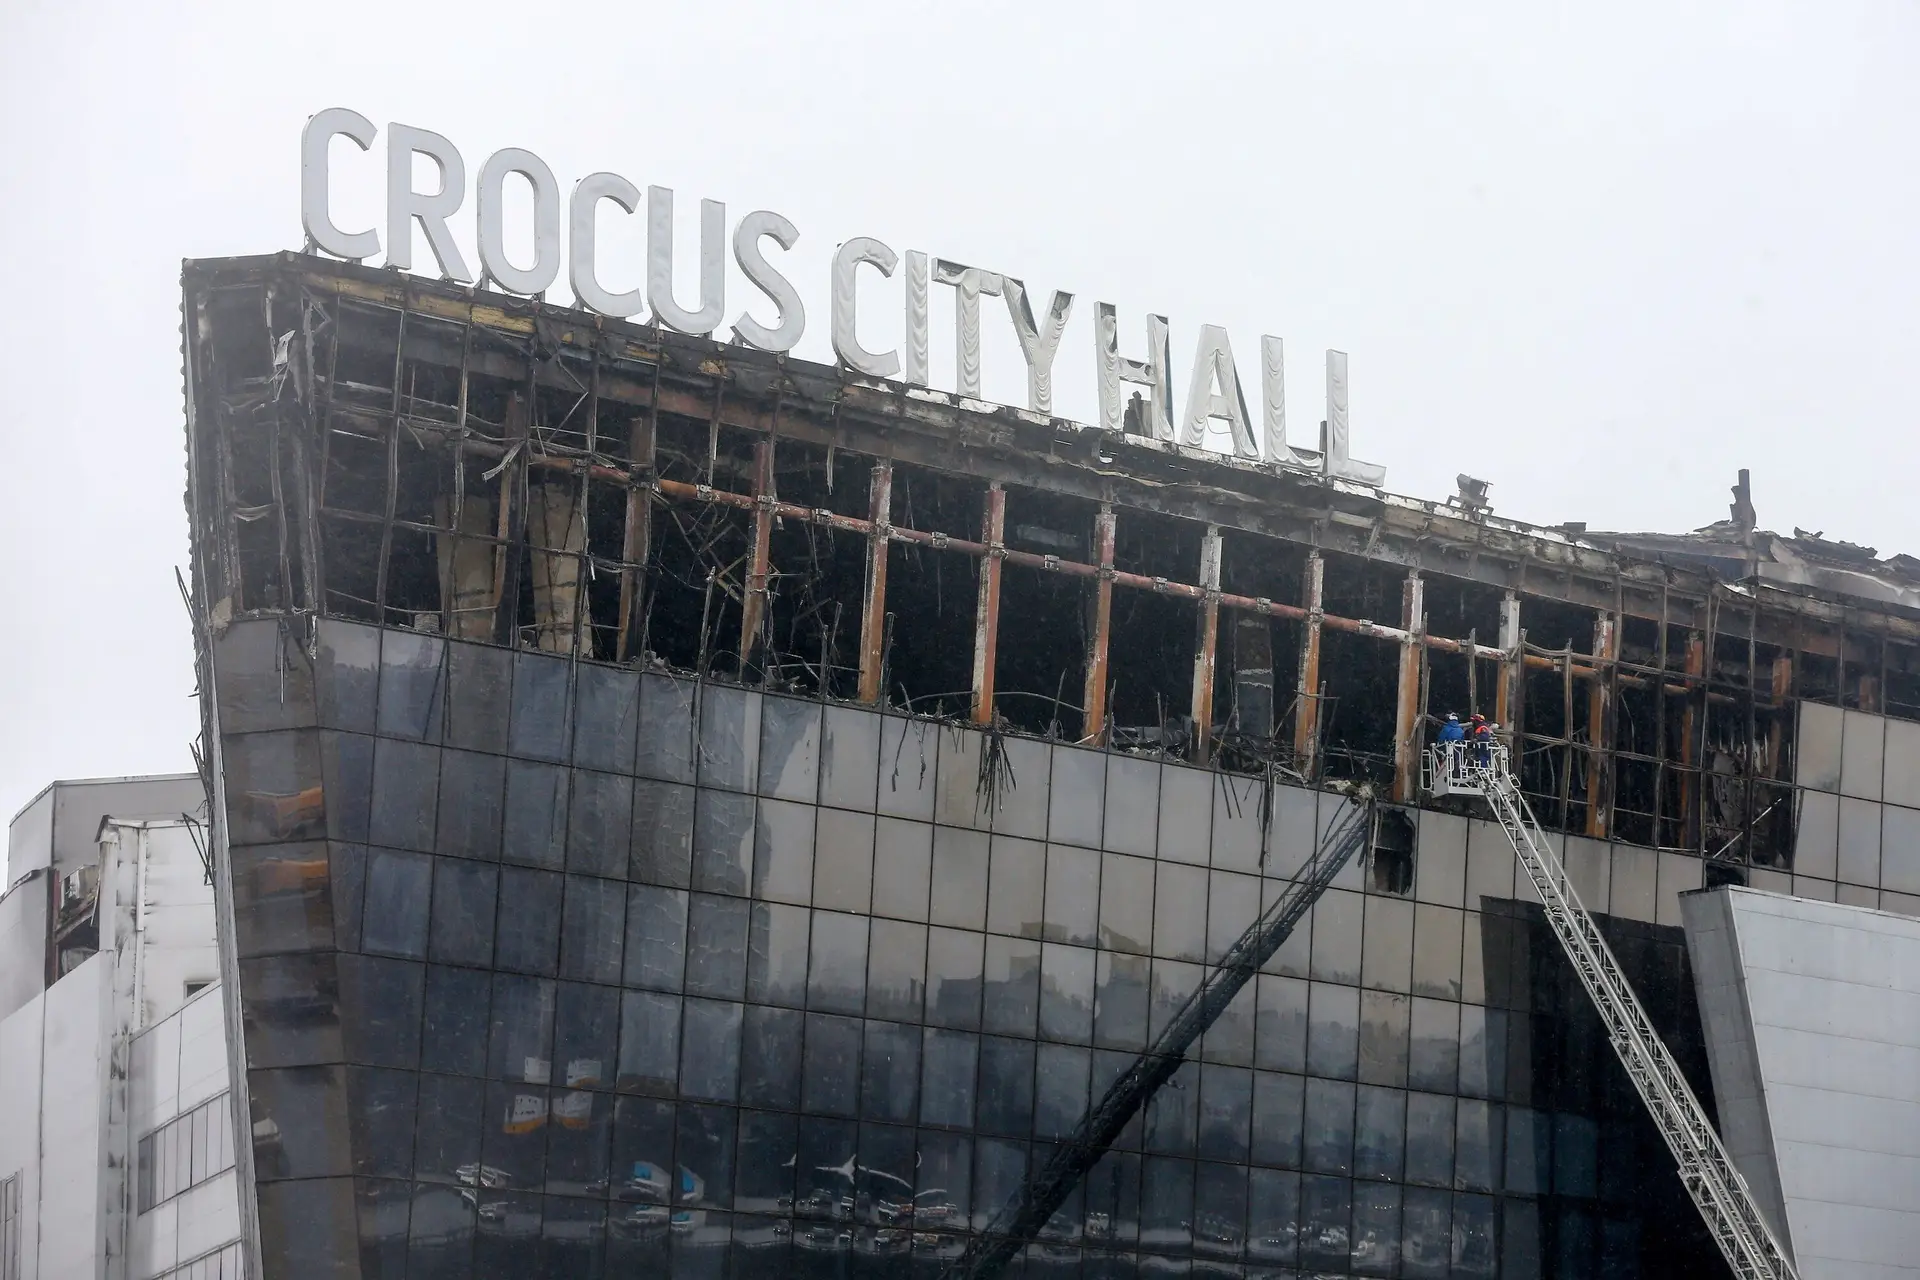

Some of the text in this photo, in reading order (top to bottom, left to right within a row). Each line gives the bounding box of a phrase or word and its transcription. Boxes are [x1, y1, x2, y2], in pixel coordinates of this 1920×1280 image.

[301, 107, 1386, 487] CROCUS CITY HALL
